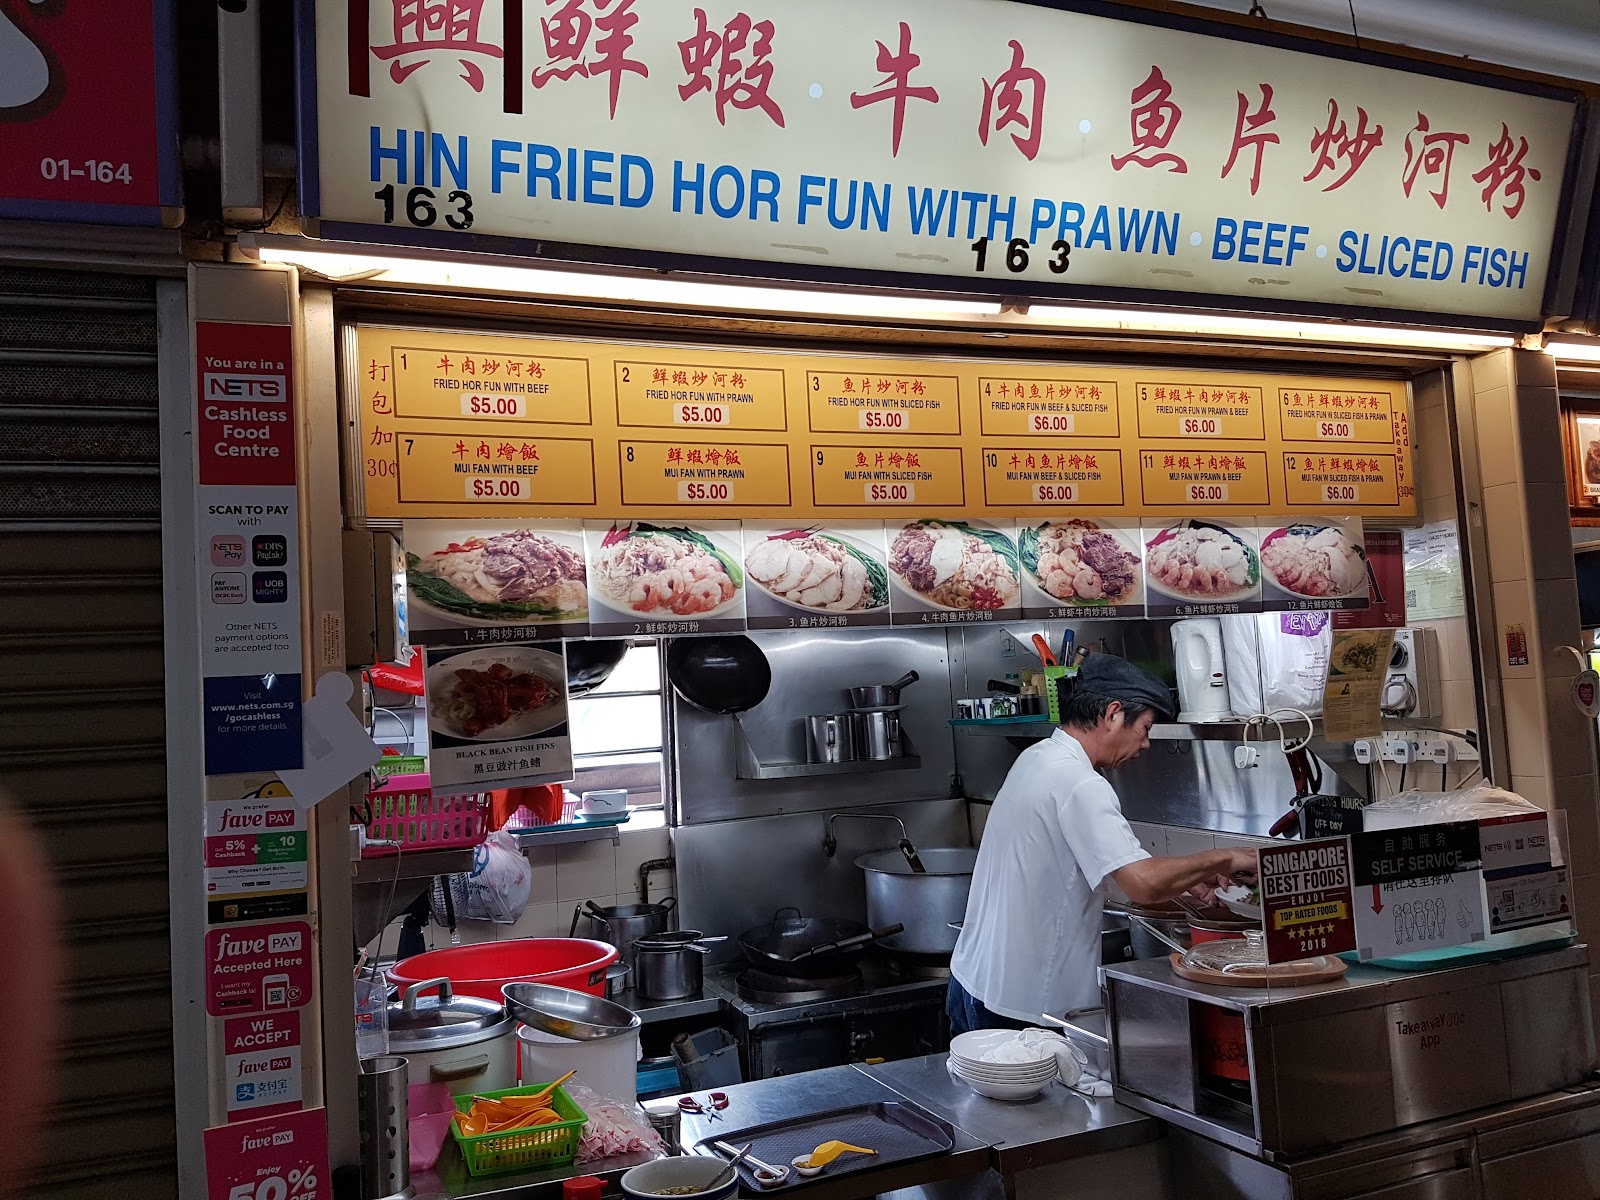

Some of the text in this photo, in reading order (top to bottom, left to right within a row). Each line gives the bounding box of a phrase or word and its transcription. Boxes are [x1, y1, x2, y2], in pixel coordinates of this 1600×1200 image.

[850, 22, 1047, 160] 牛肉
[1111, 65, 1541, 219] 魚片炒河粉
[40, 157, 132, 185] 01-164
[369, 126, 1529, 290] HIN FRIED HOR FUN WITH PRAWN BEEF SLICED FISH
[374, 183, 474, 231] 163
[204, 356, 284, 370] You are in a
[400, 354, 546, 379] 1 牛肉炒河粉
[622, 367, 747, 389] 2 鮮蝦炒河粉
[210, 378, 280, 397] NETS
[433, 378, 550, 394] FRIED HOR FUN WITH BEEF
[813, 376, 927, 397] 3 魚片炒河粉
[984, 382, 992, 397] 4
[646, 389, 754, 404] FRIED HOR FUN WITH PRAWN
[1141, 387, 1147, 401] 5
[1283, 393, 1289, 406] 6
[470, 395, 517, 415] $5.00
[204, 406, 287, 422] Cashless
[367, 358, 398, 477] 打包加 30¢
[682, 405, 722, 424] $5.00
[865, 410, 902, 428] $5.00
[1034, 415, 1068, 431] $6.00
[1185, 419, 1215, 434] $6.00
[1321, 422, 1349, 437] $6.00
[1400, 413, 1409, 446] Add
[223, 424, 270, 439] Food
[214, 442, 279, 457] Centre
[405, 440, 540, 461] 7 牛肉燴飯
[626, 446, 741, 466] 8 鮮蝦燴飯
[816, 451, 824, 466] 9
[985, 453, 998, 468] 10
[1142, 455, 1153, 469] 11
[1285, 456, 1296, 470] 12
[454, 463, 539, 475] MUI FAN WITH BEEF
[473, 478, 520, 498] $5.00
[687, 483, 728, 500] $5.00
[871, 484, 907, 500] $5.00
[1038, 486, 1072, 501] $6.00
[1191, 485, 1222, 501] $6.00
[1327, 485, 1354, 500] $6.00
[208, 505, 289, 515] SCAN TO PAY
[236, 517, 261, 526] with
[265, 542, 283, 550] DBS
[224, 551, 242, 560] Pay
[931, 610, 993, 623] 牛肉鱼片炒河粉
[1058, 606, 1117, 619] 鲜虾牛肉炒河粉
[1184, 603, 1240, 615] 鱼片鲜虾炒河粉
[226, 622, 277, 631] Other NETS
[645, 621, 700, 634] 鲜虾炒河粉
[800, 616, 848, 628] 鱼片炒河粉
[214, 633, 289, 643] payment options
[476, 627, 538, 640] 牛肉炒河粉
[214, 645, 229, 653] are
[230, 643, 272, 653] accepted
[243, 692, 262, 700] Visit
[210, 701, 295, 713] www.nets.com.sg
[225, 712, 281, 723] /gocashless
[217, 724, 257, 733] for more
[455, 742, 555, 759] BLACK BEAN FISH FINS
[1341, 797, 1364, 811] HOURS
[217, 808, 293, 832] fave PAY
[1314, 818, 1344, 832] OFF DAY
[225, 840, 246, 851] 5%
[279, 836, 296, 846] 10
[1384, 831, 1447, 854] 自助服务
[1484, 843, 1503, 852] NETS
[1262, 845, 1346, 876] SINGAPORE
[1371, 850, 1463, 876] SELF SERVICE
[1266, 868, 1345, 896] BEST FOODS
[1291, 892, 1325, 906] ENJOY
[1279, 904, 1338, 922] TOP RATED FOODS
[213, 933, 298, 961] fave PAY
[1300, 937, 1327, 952] 2018
[213, 957, 303, 974] Accepted Here
[215, 989, 248, 998] Cashback
[251, 1019, 274, 1032] WE
[233, 1029, 292, 1048] ACCEPT
[1420, 1034, 1441, 1050] App
[235, 1059, 290, 1078] fave PAY
[257, 1078, 288, 1093] 支付宝
[239, 1133, 291, 1153] fave PAY
[256, 1165, 282, 1176] Enjoy
